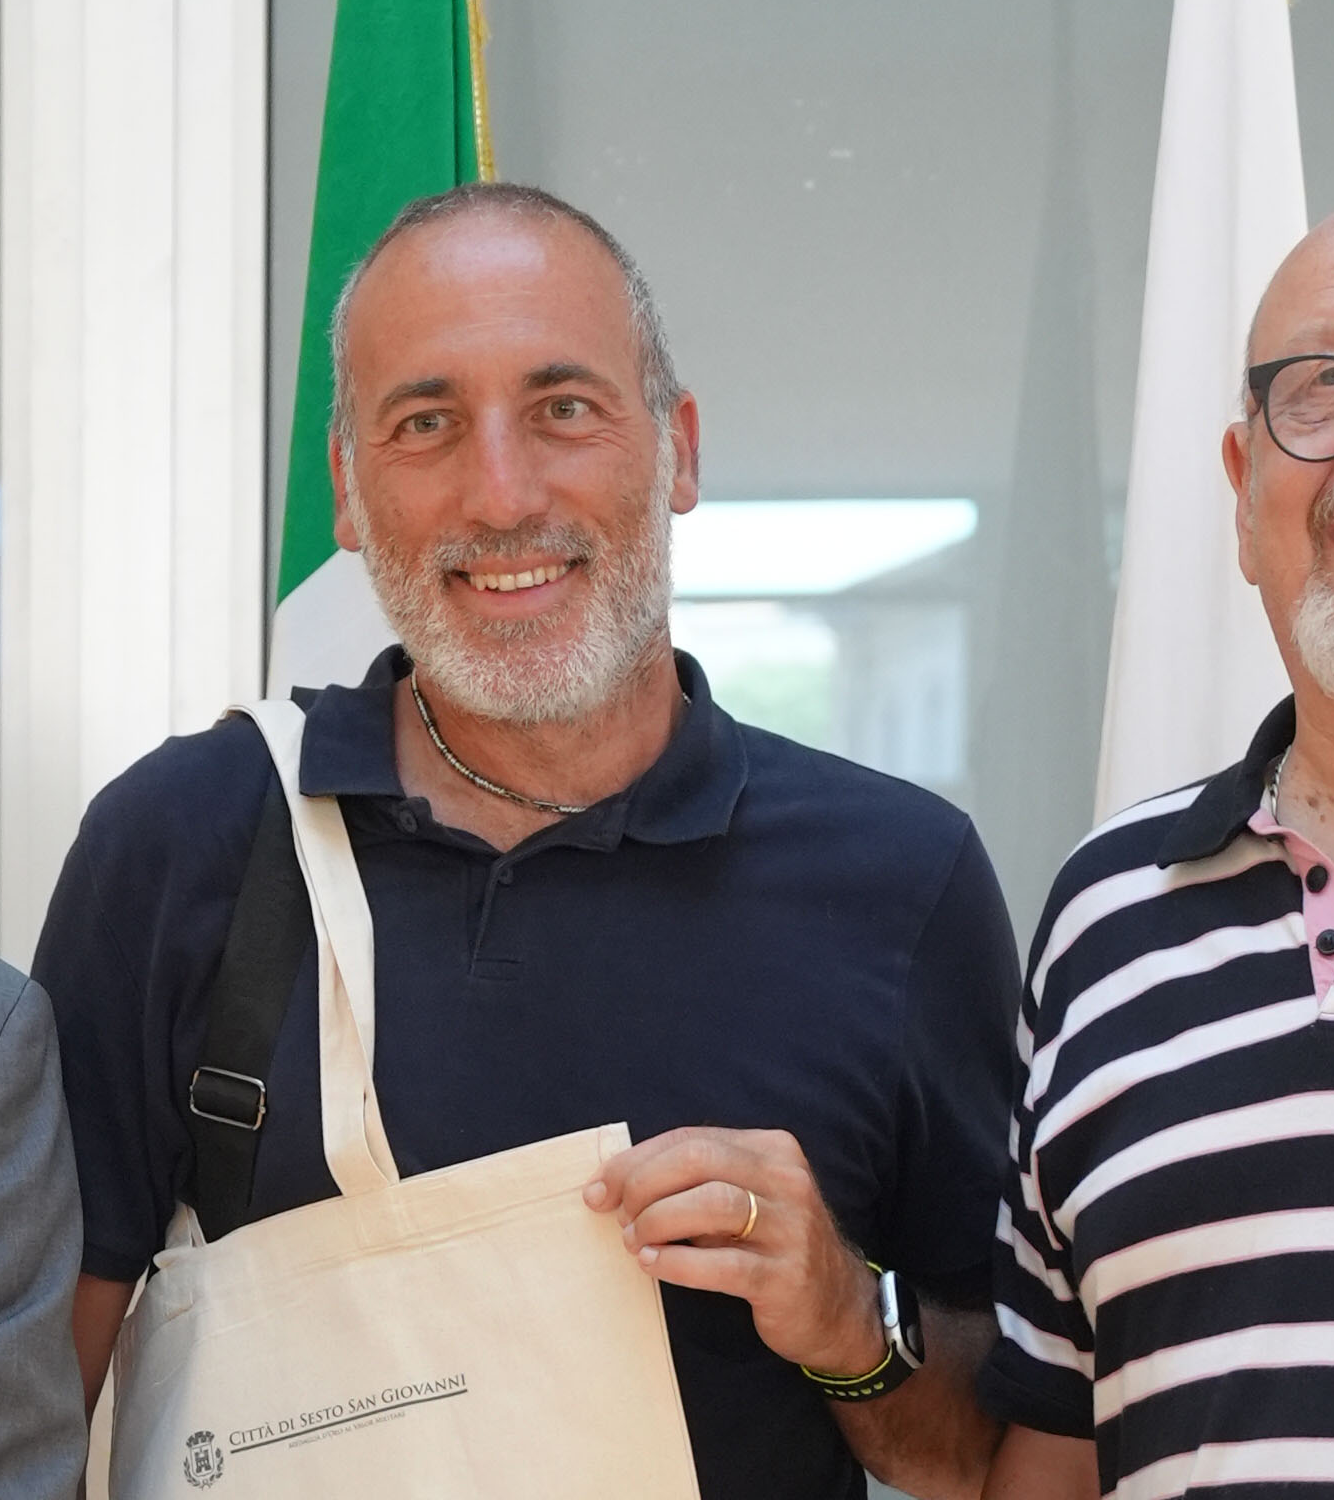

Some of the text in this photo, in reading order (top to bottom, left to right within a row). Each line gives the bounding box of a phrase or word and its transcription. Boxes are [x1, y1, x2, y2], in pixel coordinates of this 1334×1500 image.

[299, 1404, 344, 1428] SESTO
[348, 1394, 377, 1414] SAN
[381, 1373, 467, 1404] GIOVANNI
